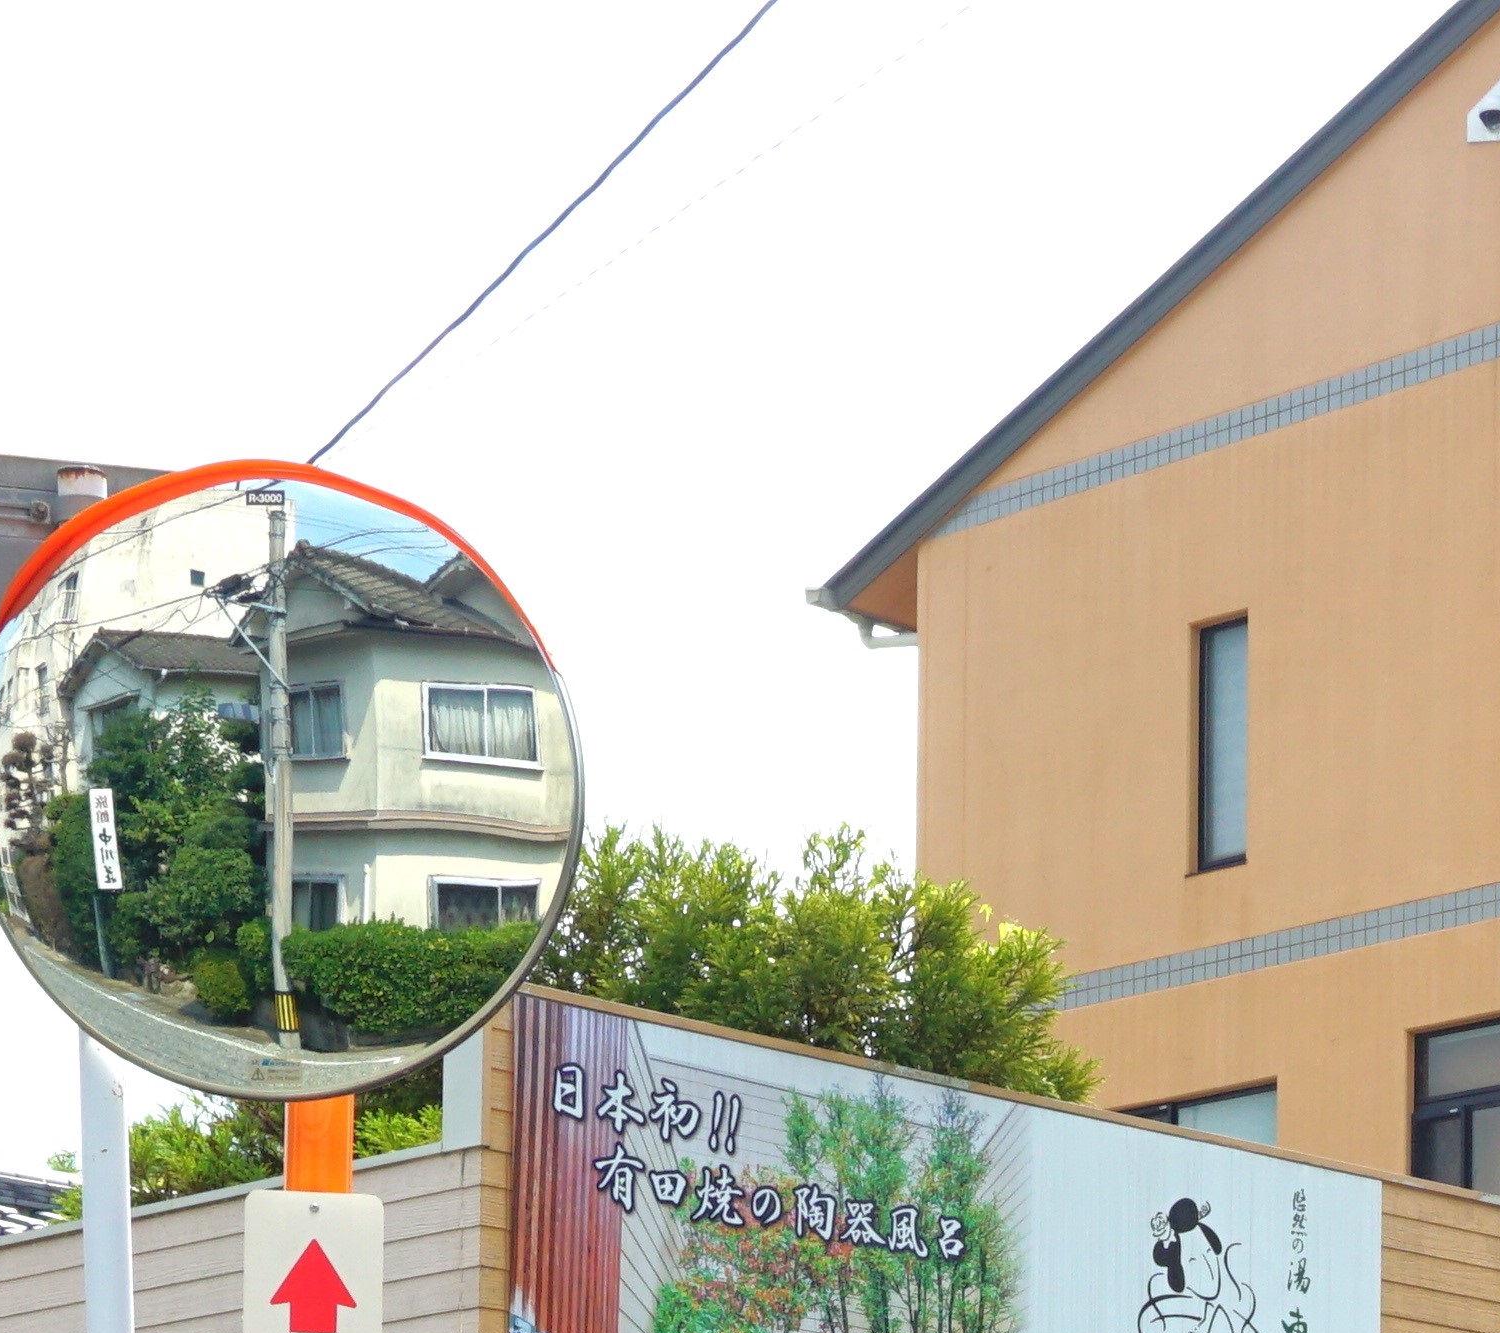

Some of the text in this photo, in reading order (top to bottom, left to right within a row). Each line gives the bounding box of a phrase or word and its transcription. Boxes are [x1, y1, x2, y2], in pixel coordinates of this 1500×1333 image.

[594, 1142, 966, 1260] 有田焼の陶器風呂
